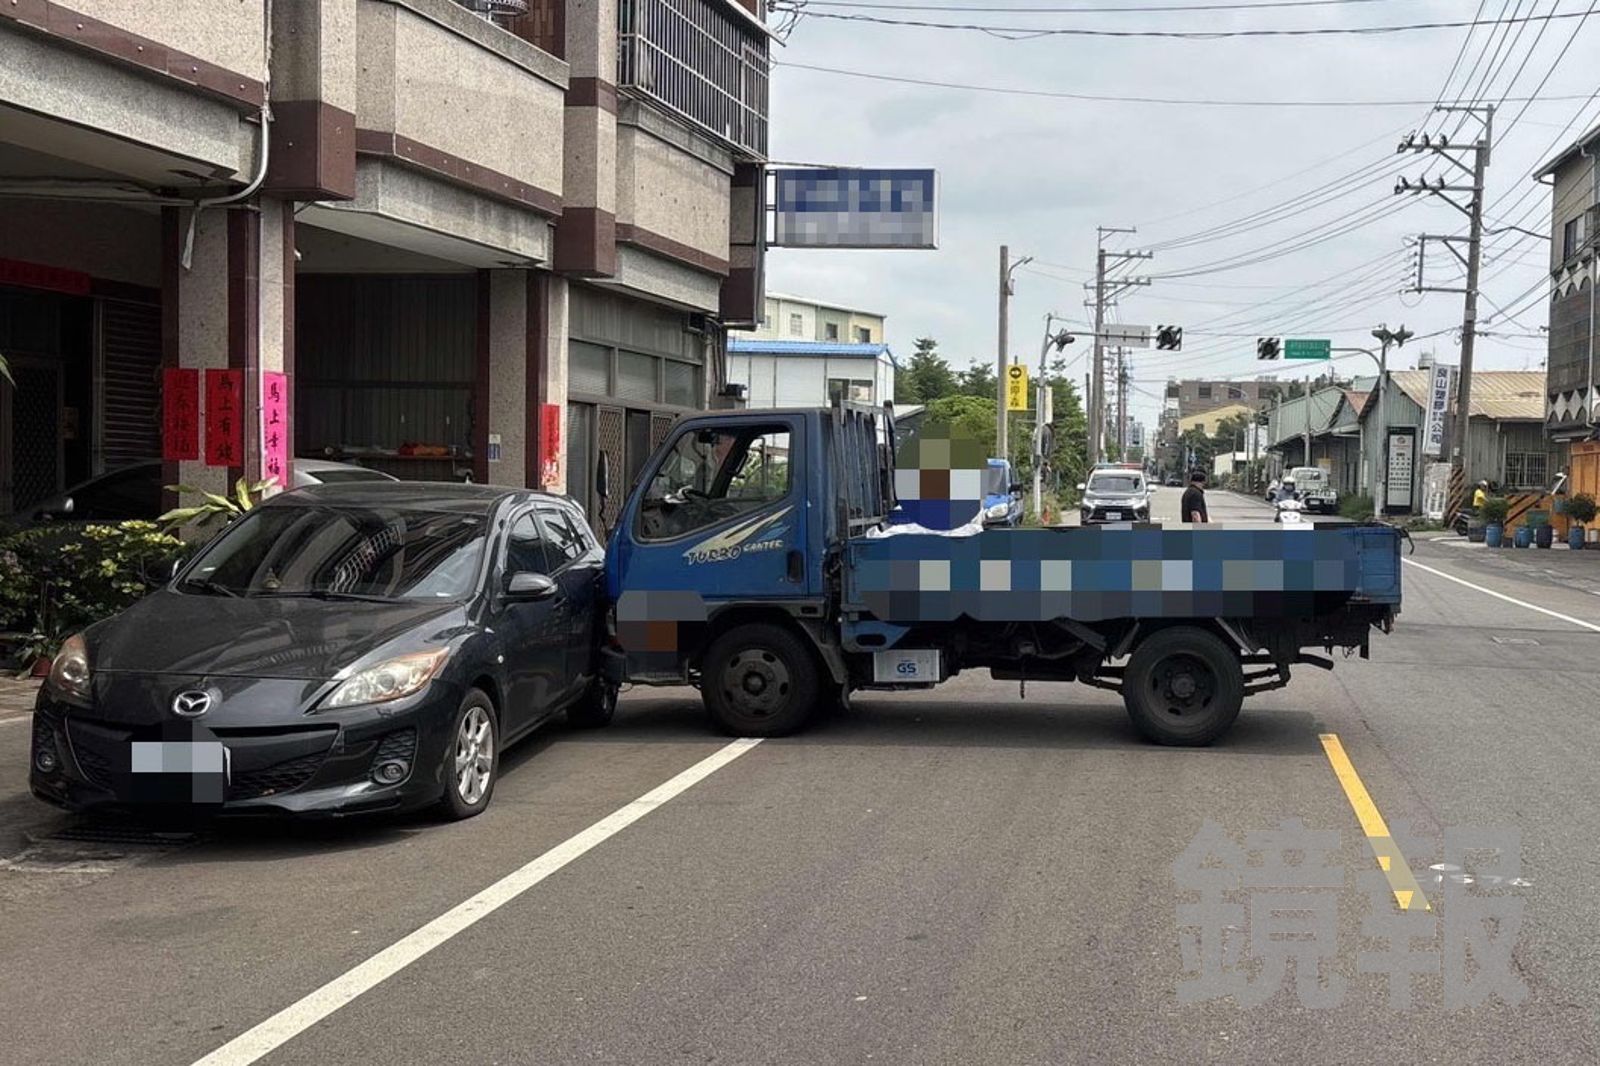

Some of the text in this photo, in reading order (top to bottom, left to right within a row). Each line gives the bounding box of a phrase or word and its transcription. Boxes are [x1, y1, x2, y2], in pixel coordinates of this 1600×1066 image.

[216, 373, 234, 461] 馬上有錢
[267, 381, 281, 476] 馬上幸福
[687, 545, 743, 566] TURBO
[896, 662, 917, 674] GS
